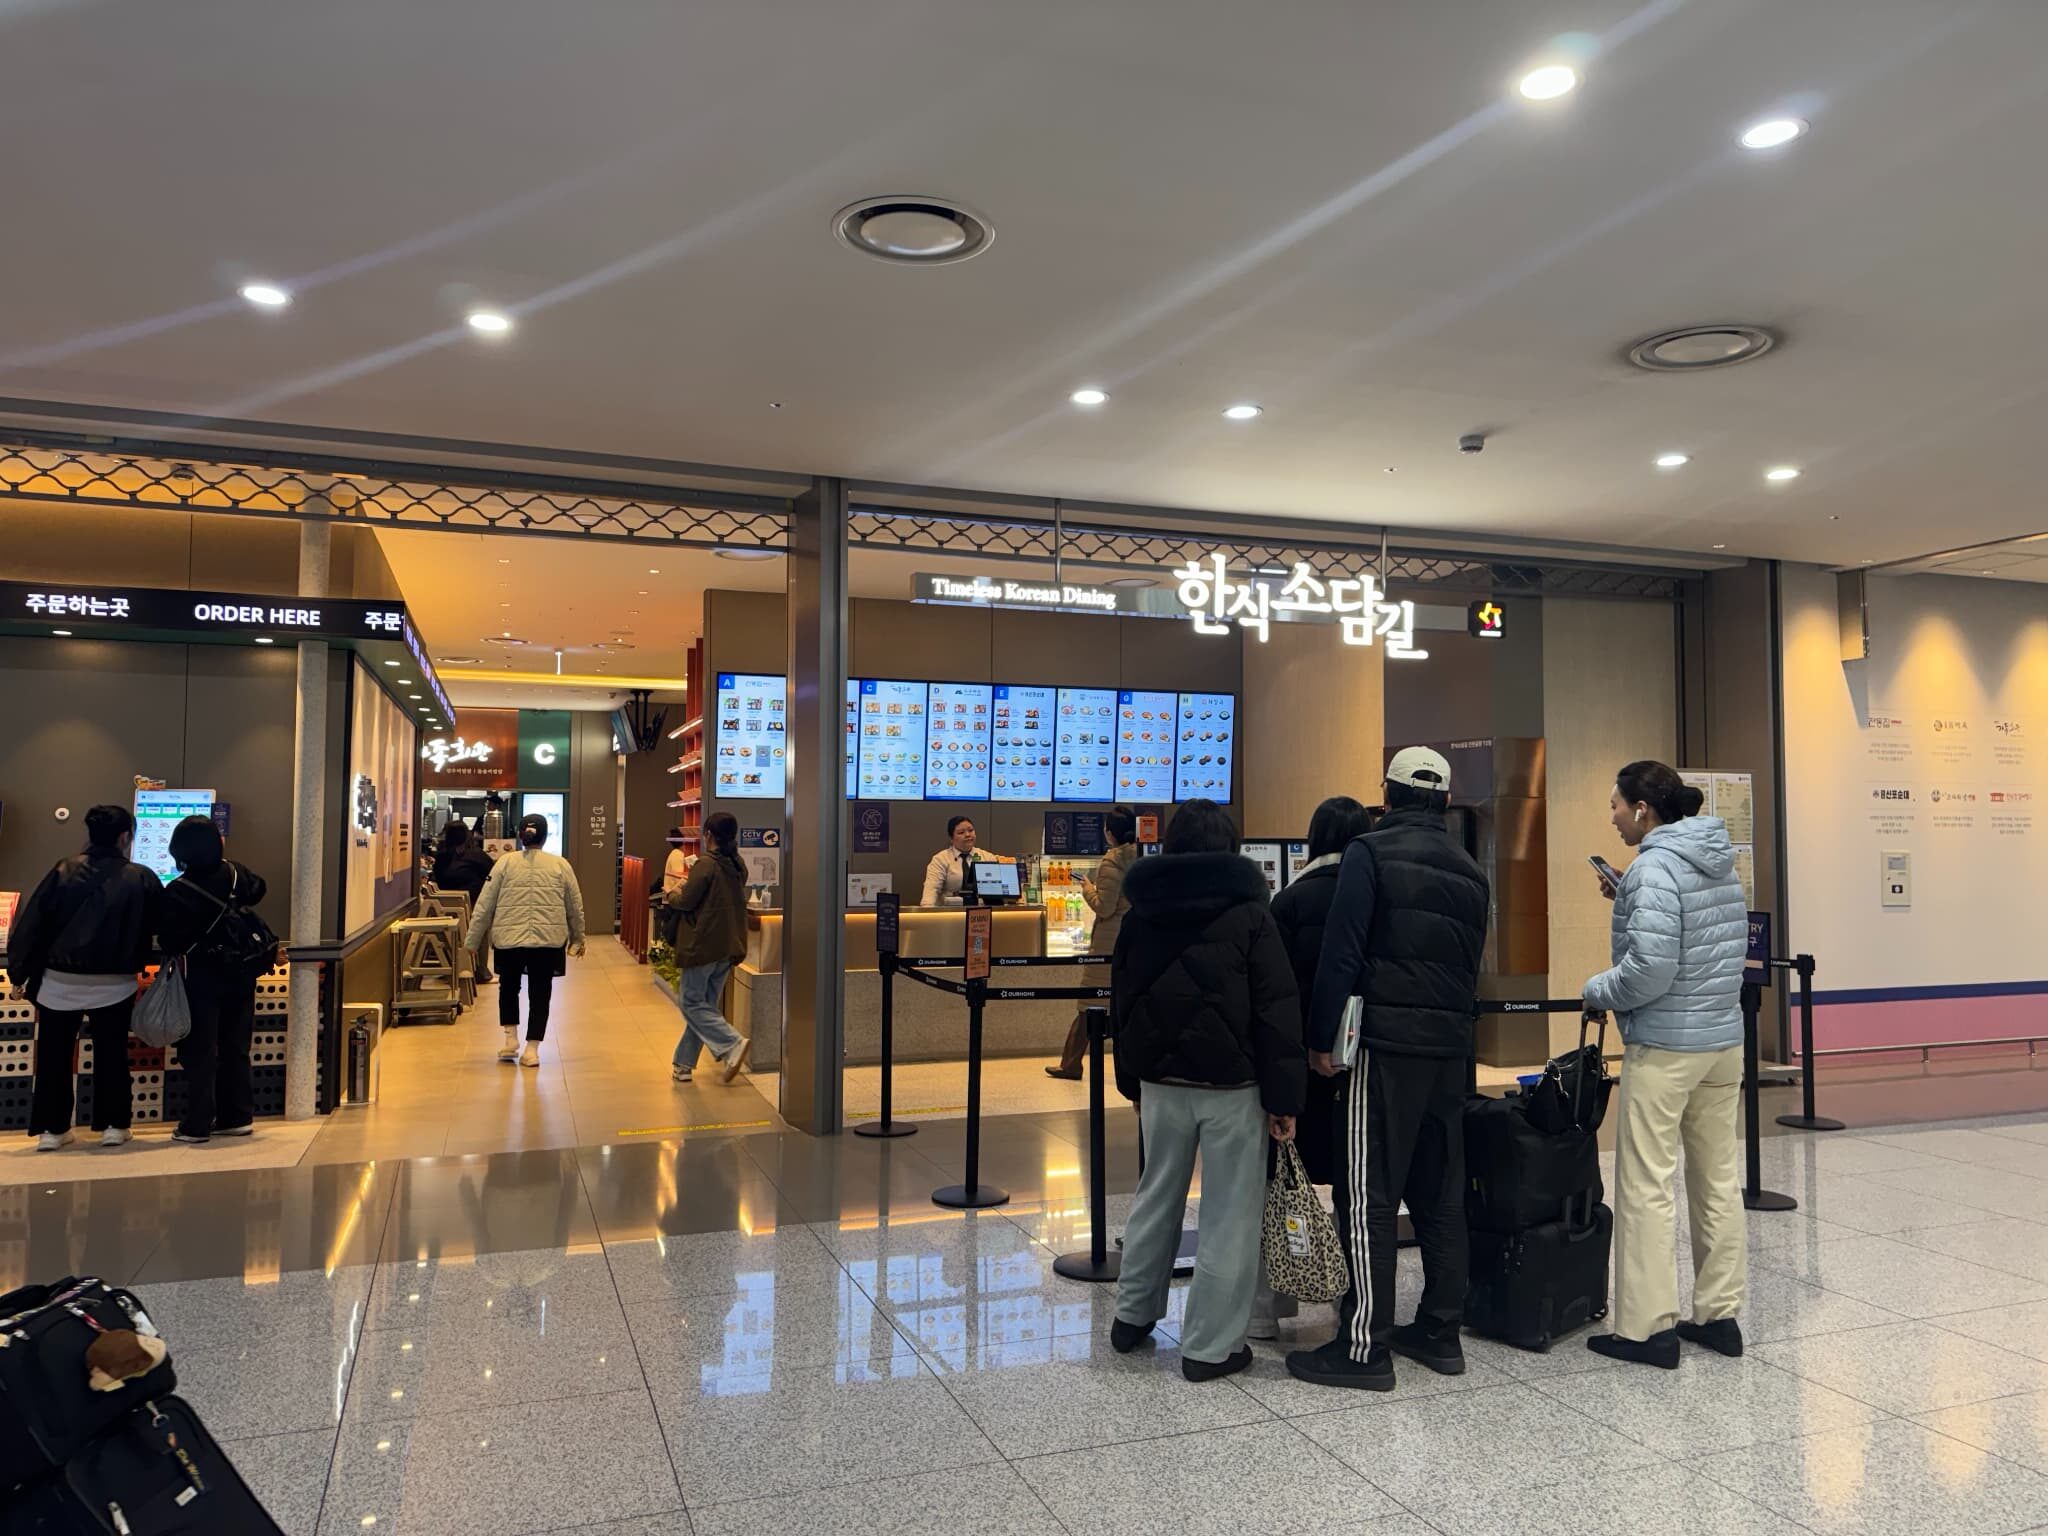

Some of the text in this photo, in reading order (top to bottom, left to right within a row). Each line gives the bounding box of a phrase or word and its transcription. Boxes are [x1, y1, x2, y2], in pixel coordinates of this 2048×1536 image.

[25, 592, 131, 618] 주문하는곳
[932, 578, 1117, 610] Timeless Korean Dining
[1172, 552, 1430, 661] 한식소담길
[194, 603, 321, 627] ORDER HERE
[364, 611, 404, 631] 주문
[533, 743, 555, 765] C
